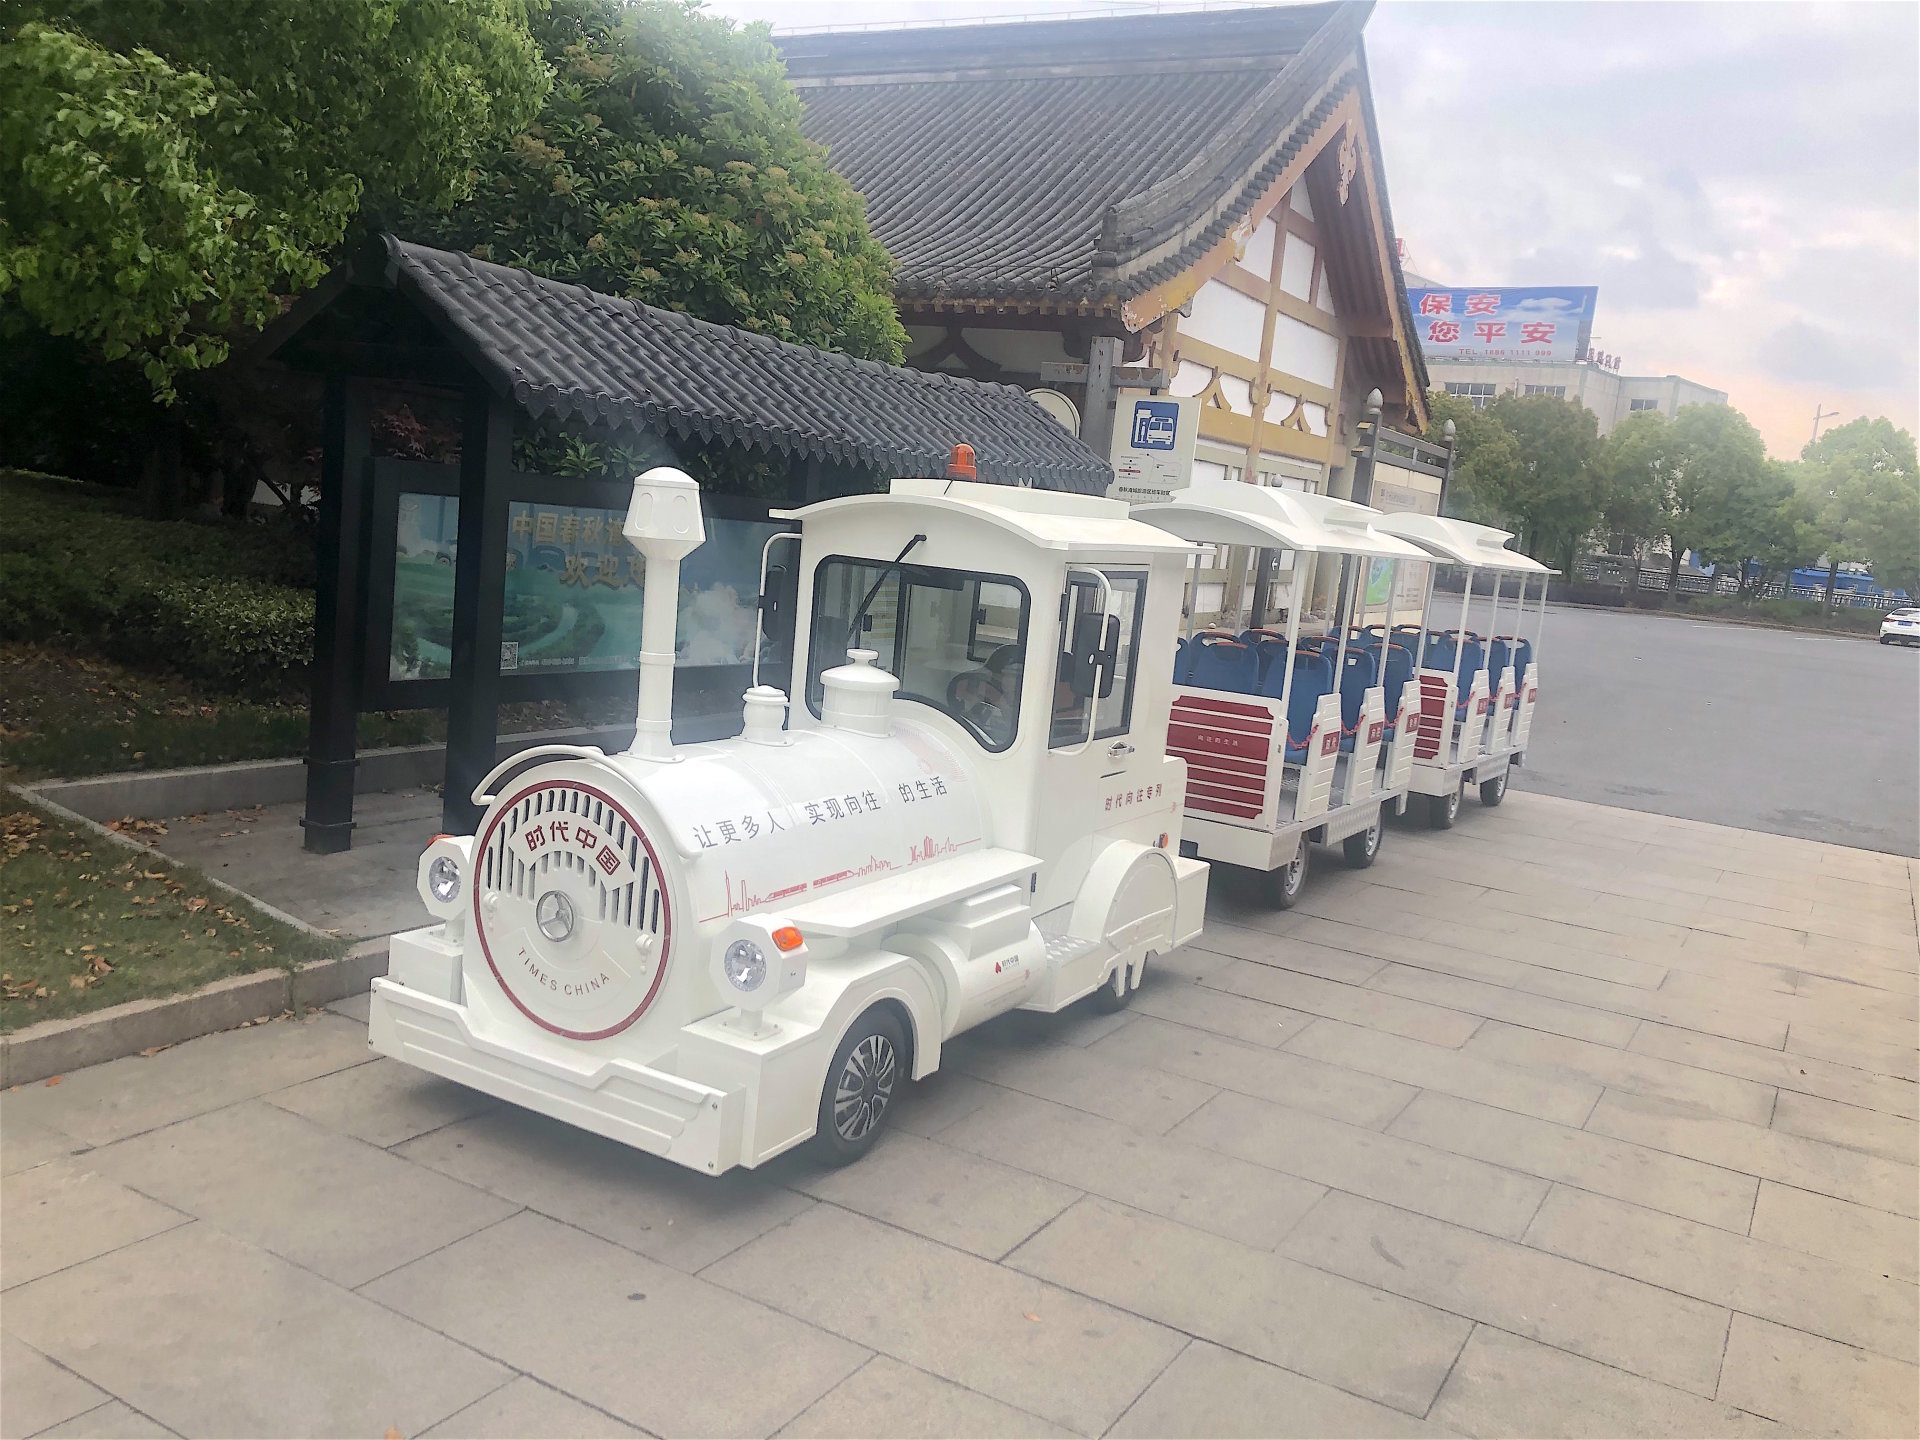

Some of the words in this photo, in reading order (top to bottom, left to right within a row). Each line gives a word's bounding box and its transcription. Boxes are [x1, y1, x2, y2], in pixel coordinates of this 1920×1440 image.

[1420, 293, 1501, 316] 保安
[1428, 321, 1556, 344] 您平安
[692, 810, 785, 849] 让更多人
[804, 789, 881, 826] 实现向往
[898, 776, 948, 804] 的生活
[525, 821, 621, 876] 时代中国
[518, 947, 557, 991] TIMES
[564, 972, 610, 996] CHINA
